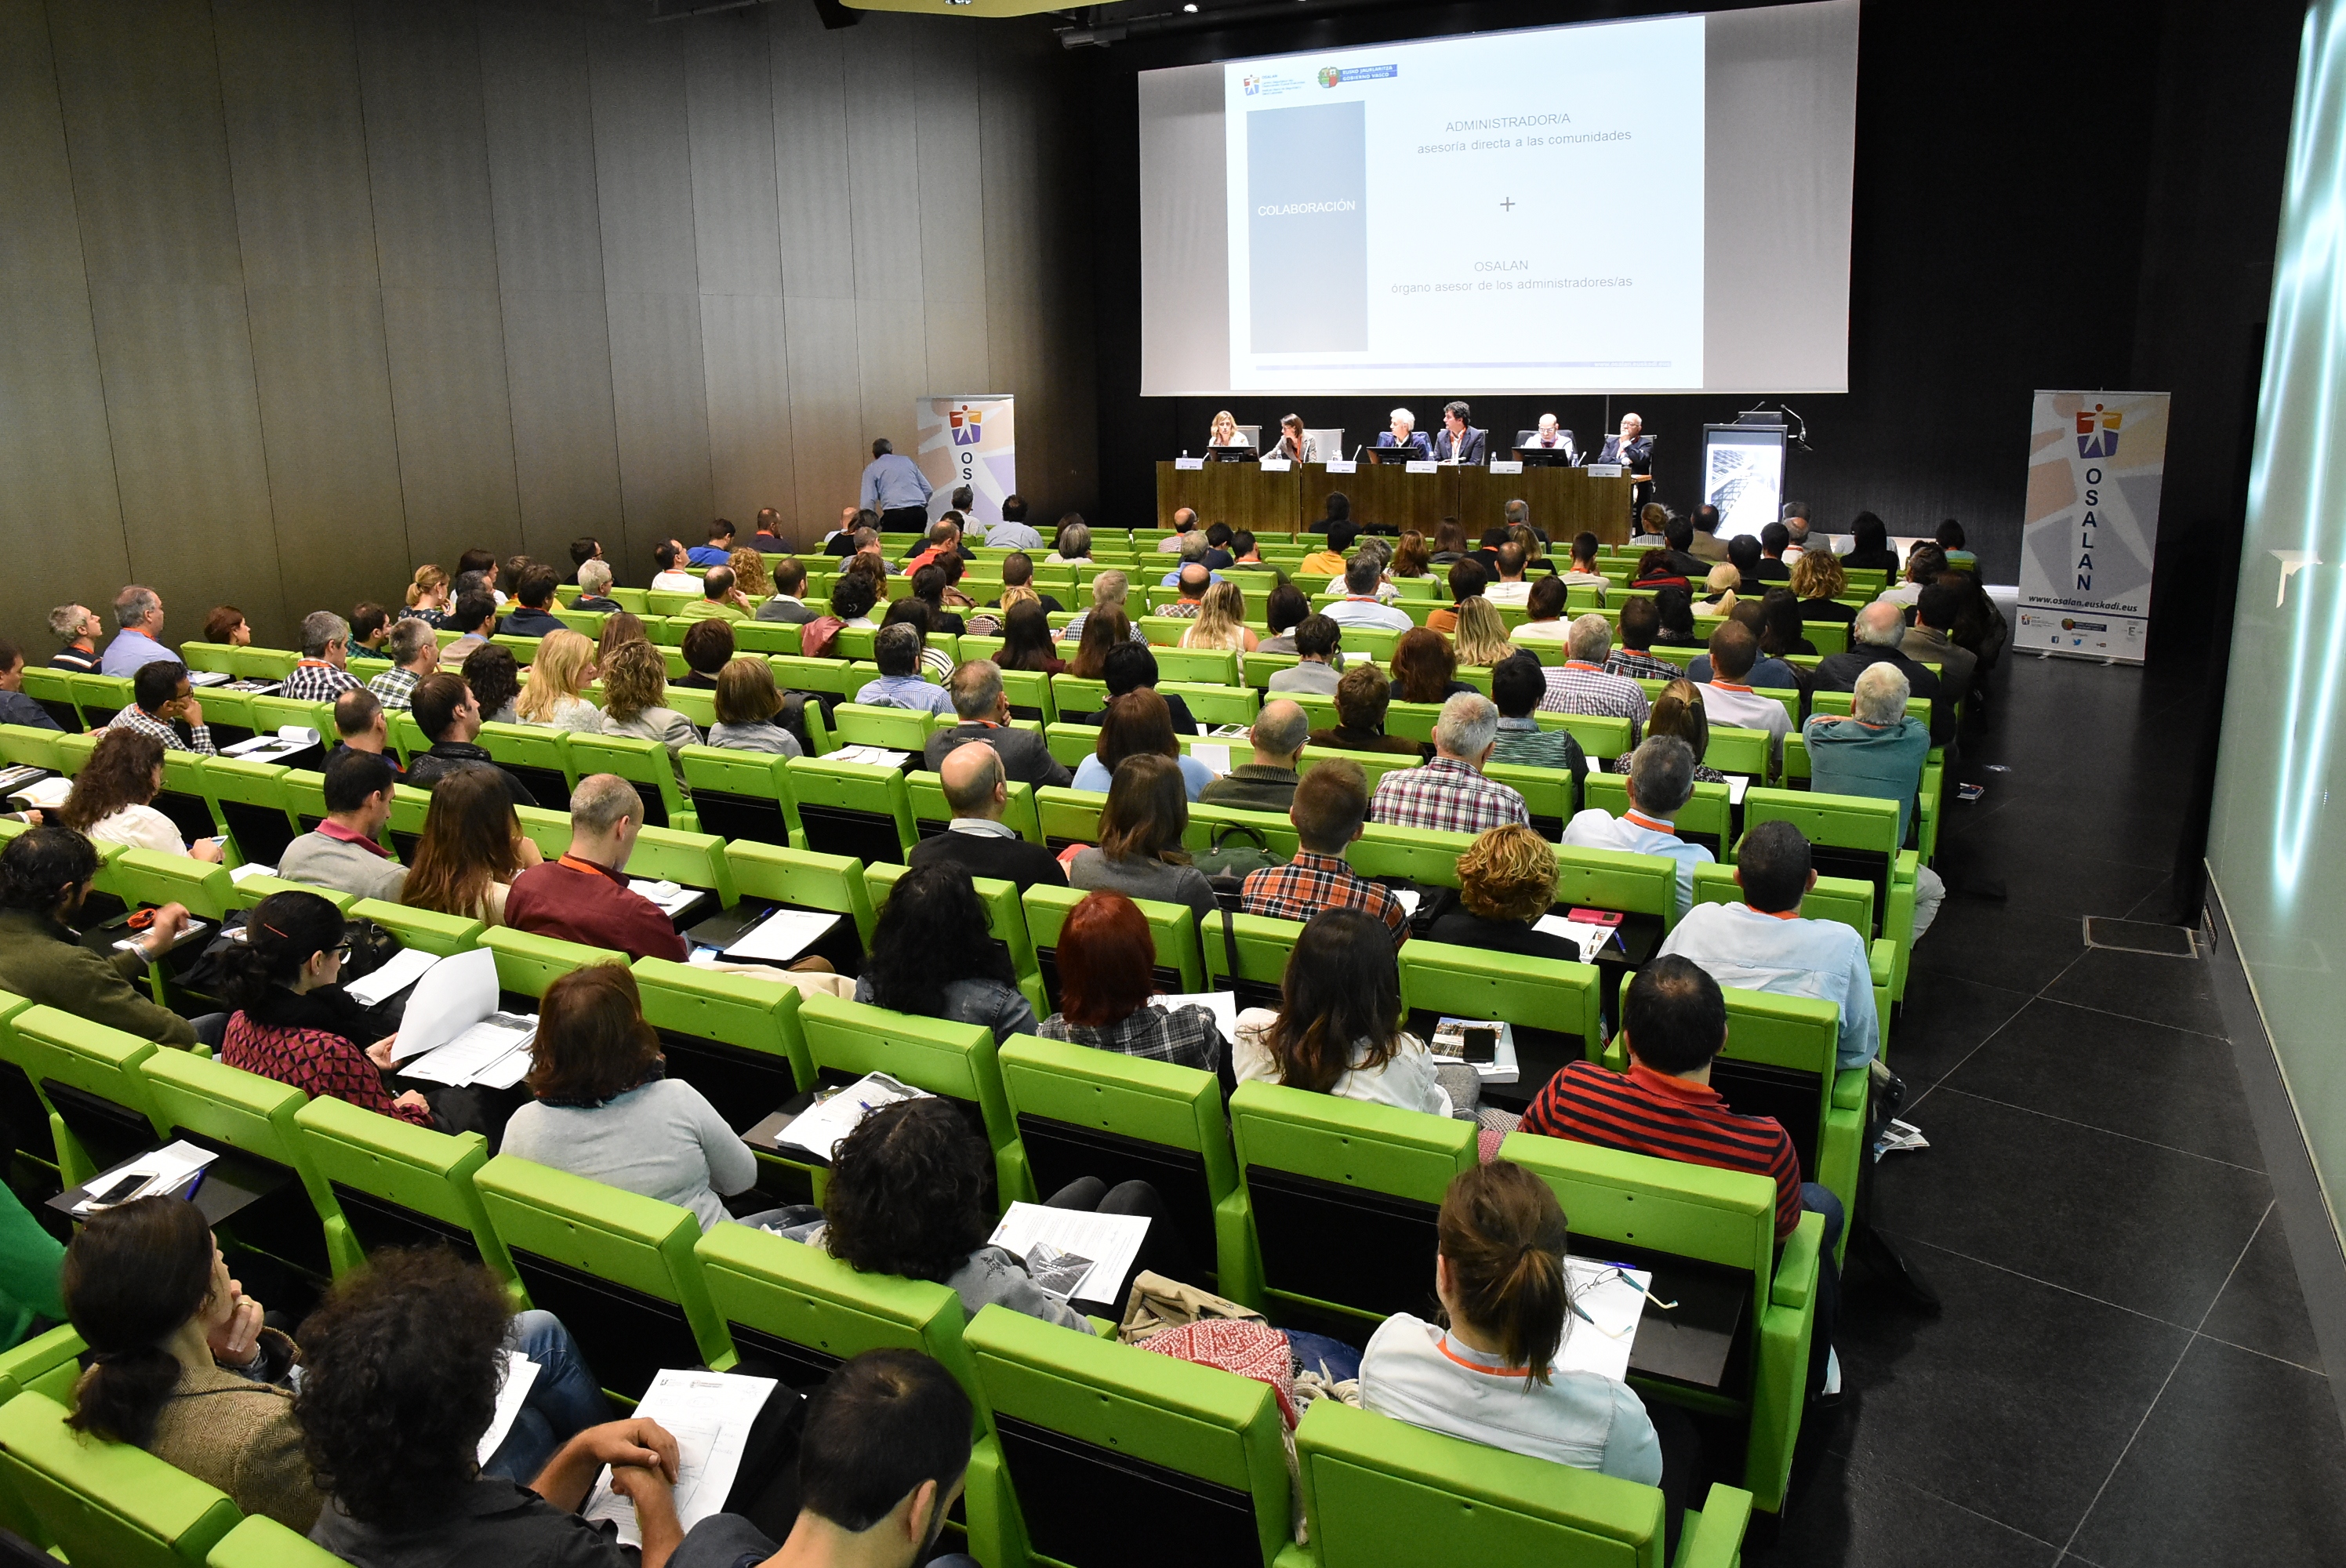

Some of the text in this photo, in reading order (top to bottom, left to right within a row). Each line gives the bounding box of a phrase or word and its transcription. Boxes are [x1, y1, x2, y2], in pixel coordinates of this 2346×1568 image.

[1360, 65, 1393, 74] JAURLARITZA
[1446, 113, 1571, 132] ADMINISTRADOR/A
[1417, 130, 1632, 154] asesoría directa a las comunidades
[1258, 198, 1356, 216] COLABORACIÓN
[1474, 260, 1529, 272] OSALAN
[1391, 277, 1633, 296] órgano asesor de los administradores/as
[2076, 468, 2102, 591] OSALAN
[2028, 595, 2138, 612] www.osalan.euskadi.eus
